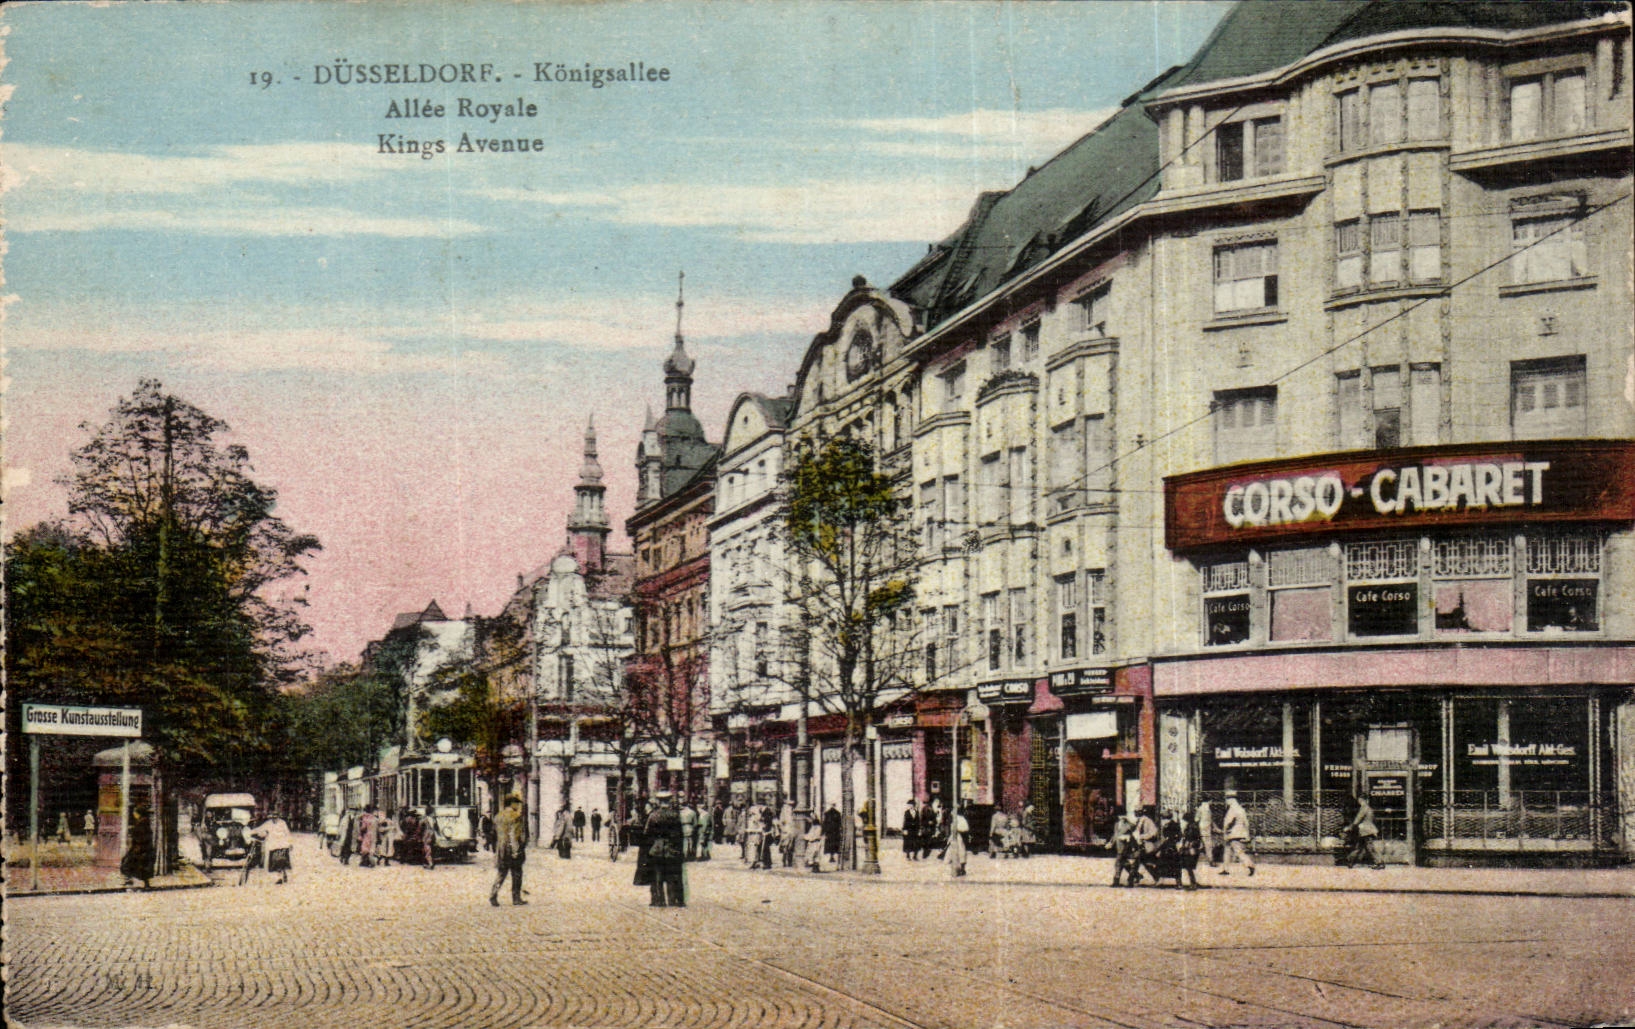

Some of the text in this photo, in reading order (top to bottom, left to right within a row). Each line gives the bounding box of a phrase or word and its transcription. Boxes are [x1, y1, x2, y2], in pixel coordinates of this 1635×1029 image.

[1381, 590, 1411, 602] Corso
[26, 706, 140, 729] Grosse Kunstausstellung
